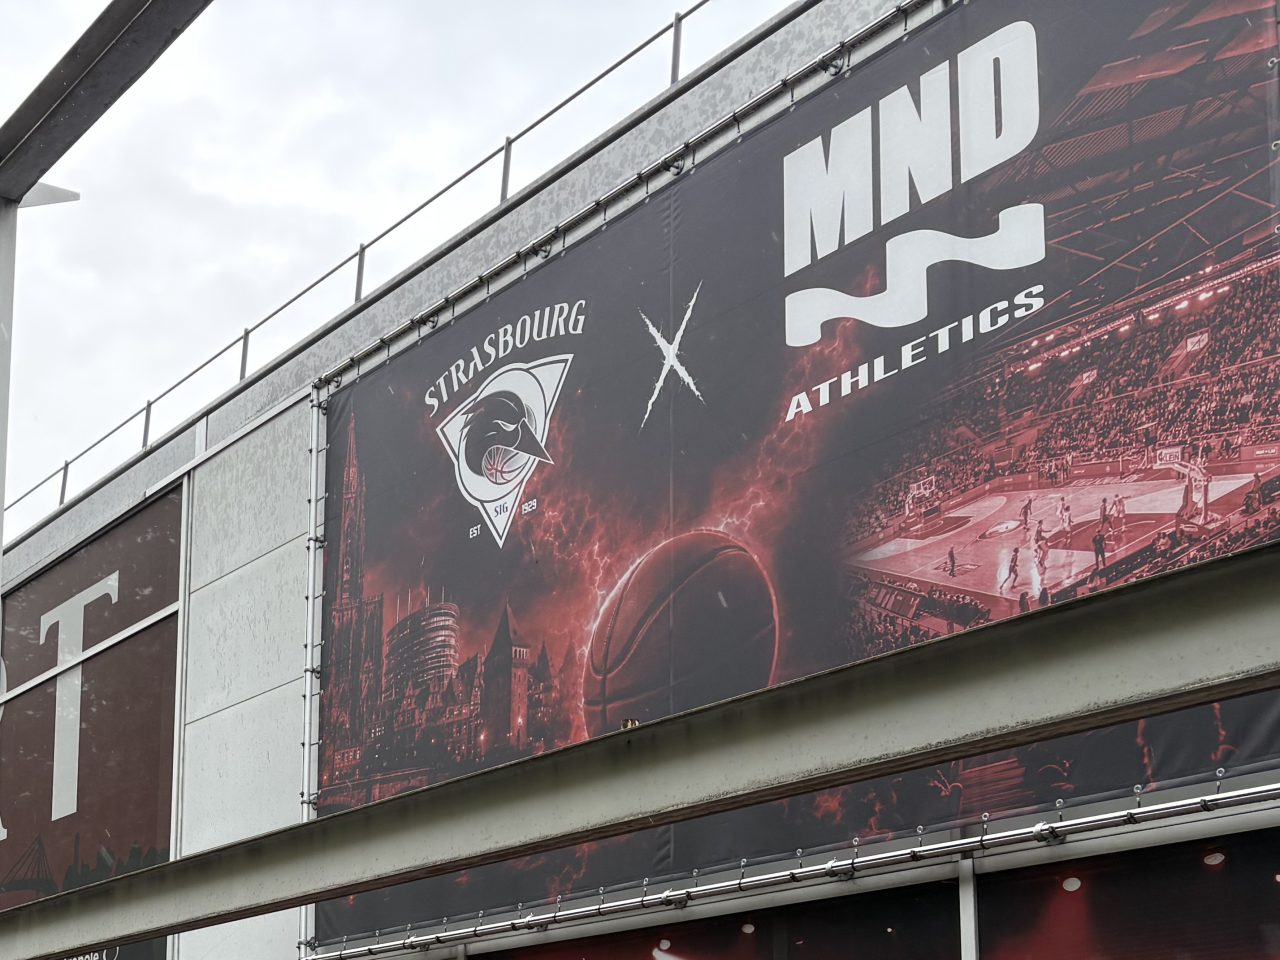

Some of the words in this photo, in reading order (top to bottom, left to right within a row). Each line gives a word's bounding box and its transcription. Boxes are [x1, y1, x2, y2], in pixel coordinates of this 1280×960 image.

[783, 20, 1040, 278] MND
[424, 299, 586, 418] STRASBOURG
[784, 284, 1045, 423] ATHLETICS
[469, 524, 481, 539] EST
[494, 502, 508, 518] SIG
[521, 498, 537, 515] 1929
